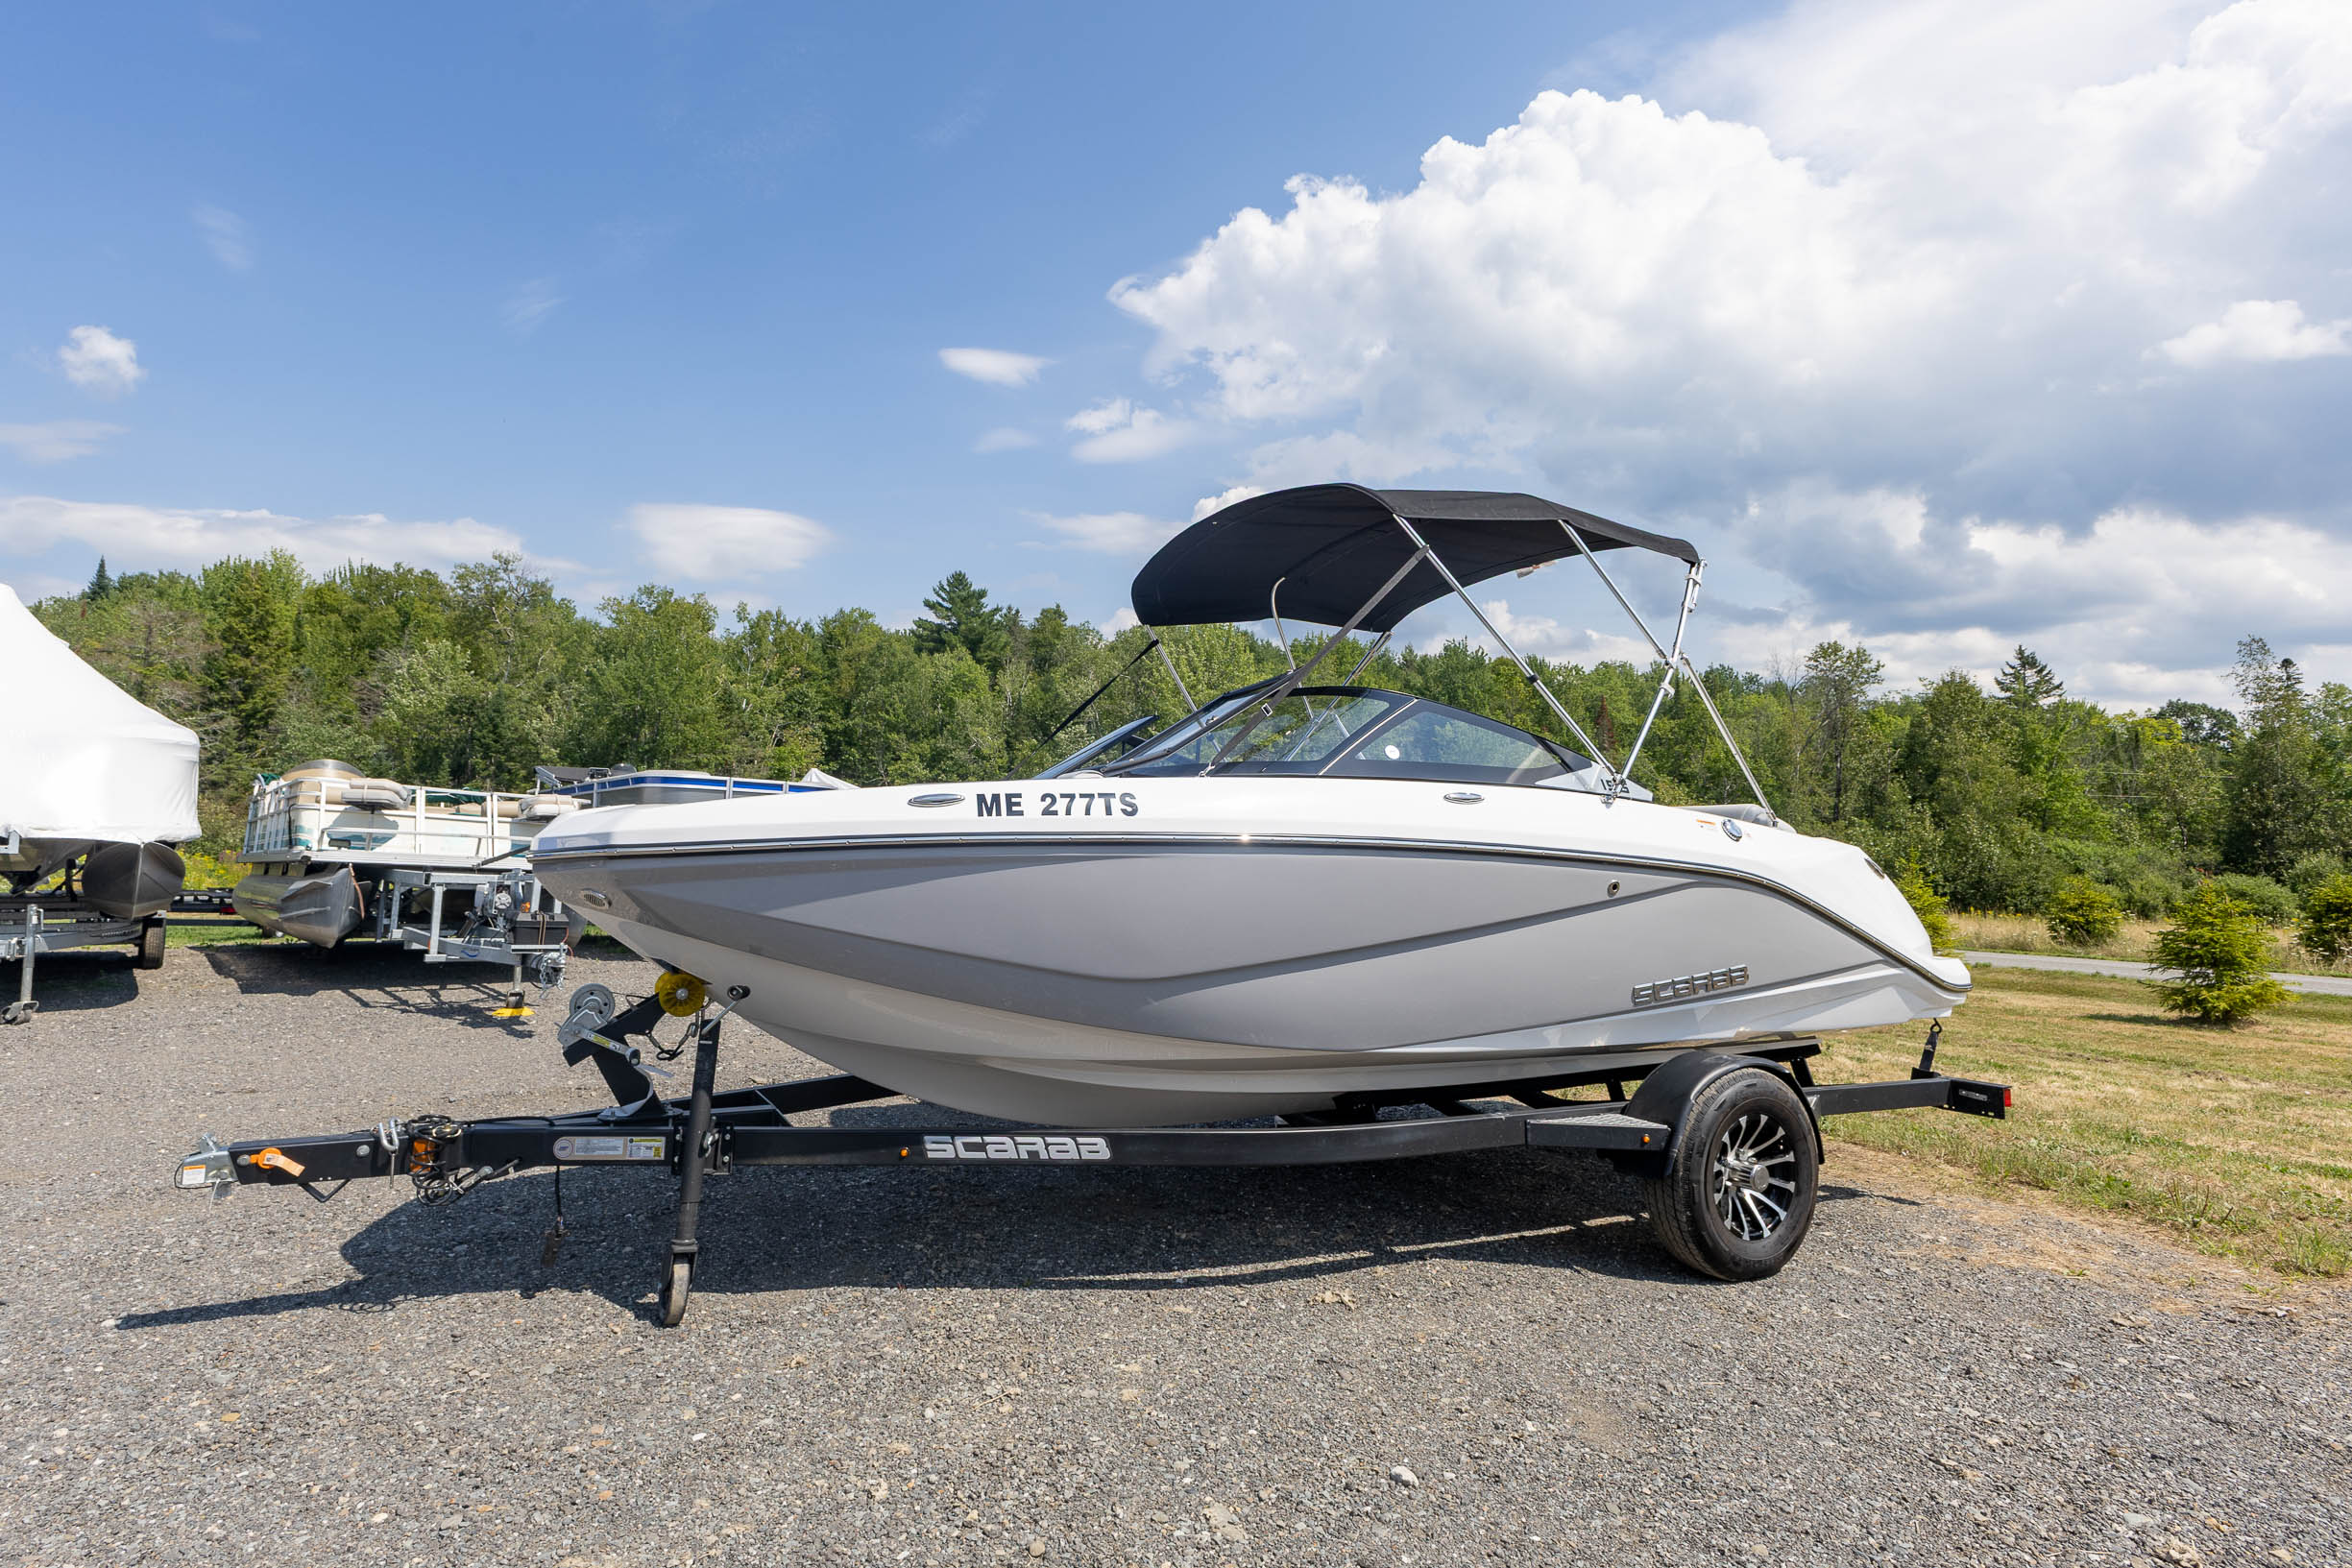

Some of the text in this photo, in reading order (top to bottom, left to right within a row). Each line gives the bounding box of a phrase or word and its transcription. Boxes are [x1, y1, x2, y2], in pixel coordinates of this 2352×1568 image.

[976, 792, 1139, 817] ME 277TS
[1632, 964, 1749, 1007] SCARAB
[923, 1135, 1111, 1160] SCARAB
